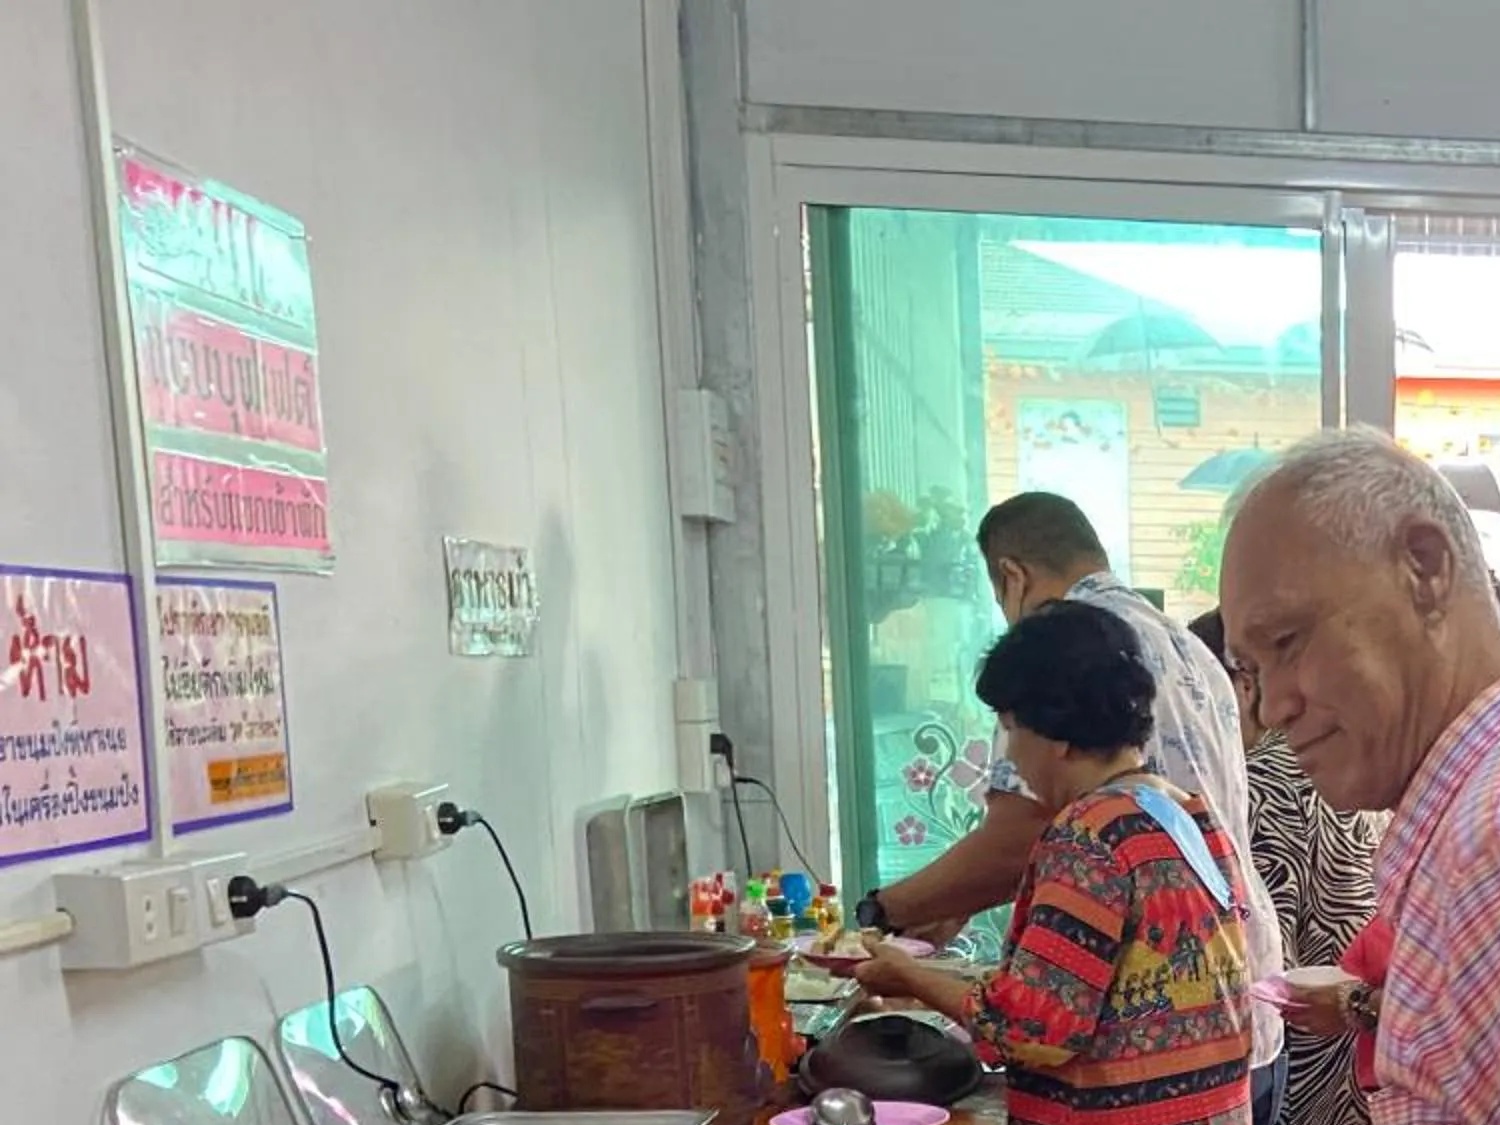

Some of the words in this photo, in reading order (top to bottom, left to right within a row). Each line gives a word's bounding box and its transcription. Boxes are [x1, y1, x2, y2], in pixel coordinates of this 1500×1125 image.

[9, 594, 90, 701] ห้าม
[0, 765, 139, 826] ในเครื่องปิ้งขนมปัง
